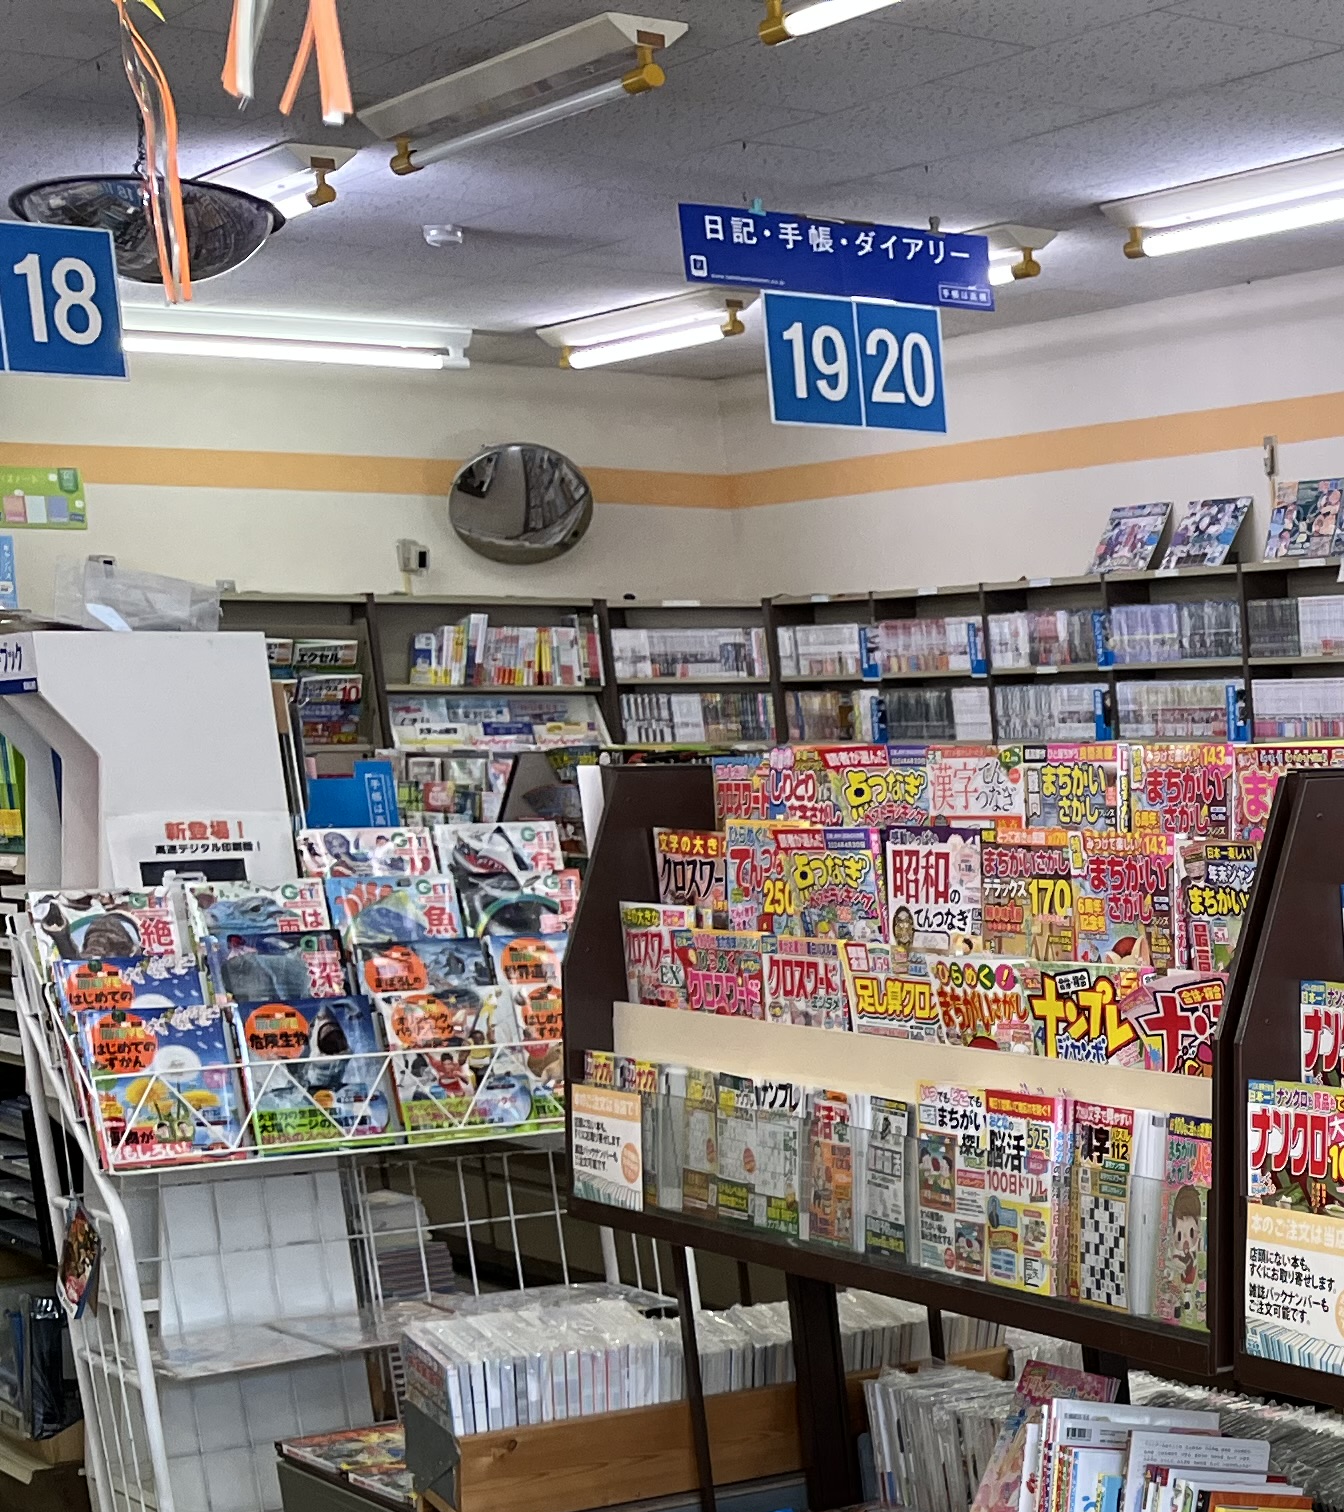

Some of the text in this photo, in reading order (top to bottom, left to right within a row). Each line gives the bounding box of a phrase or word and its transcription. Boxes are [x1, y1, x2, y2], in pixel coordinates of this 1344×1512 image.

[704, 215, 970, 264] 日記・手帳・ダイアリー
[13, 253, 102, 345] 18
[783, 322, 849, 401] 19
[866, 328, 934, 407] 20
[1203, 748, 1225, 764] 143
[1147, 769, 1223, 804] まちがい
[1145, 836, 1166, 853] 143
[892, 850, 961, 904] 昭和 の
[983, 848, 1069, 877] まちがいさがし
[1089, 857, 1166, 893] まちがい
[983, 878, 1026, 898] デラックス
[1028, 879, 1071, 916] 170
[424, 906, 457, 934] 魚
[914, 909, 969, 931] てんつなぎ
[938, 1108, 986, 1130] まちがい
[1027, 1128, 1050, 1148] 525
[1111, 1144, 1128, 1160] 112
[1252, 1105, 1329, 1183] ナンクロ
[1250, 1247, 1313, 1274] 店頭にない本も、
[1250, 1264, 1336, 1293] すぐにお取り寄せします。
[1248, 1284, 1328, 1314] 雑誌バックナンバーも
[1248, 1302, 1312, 1327] ご注文可能です。
